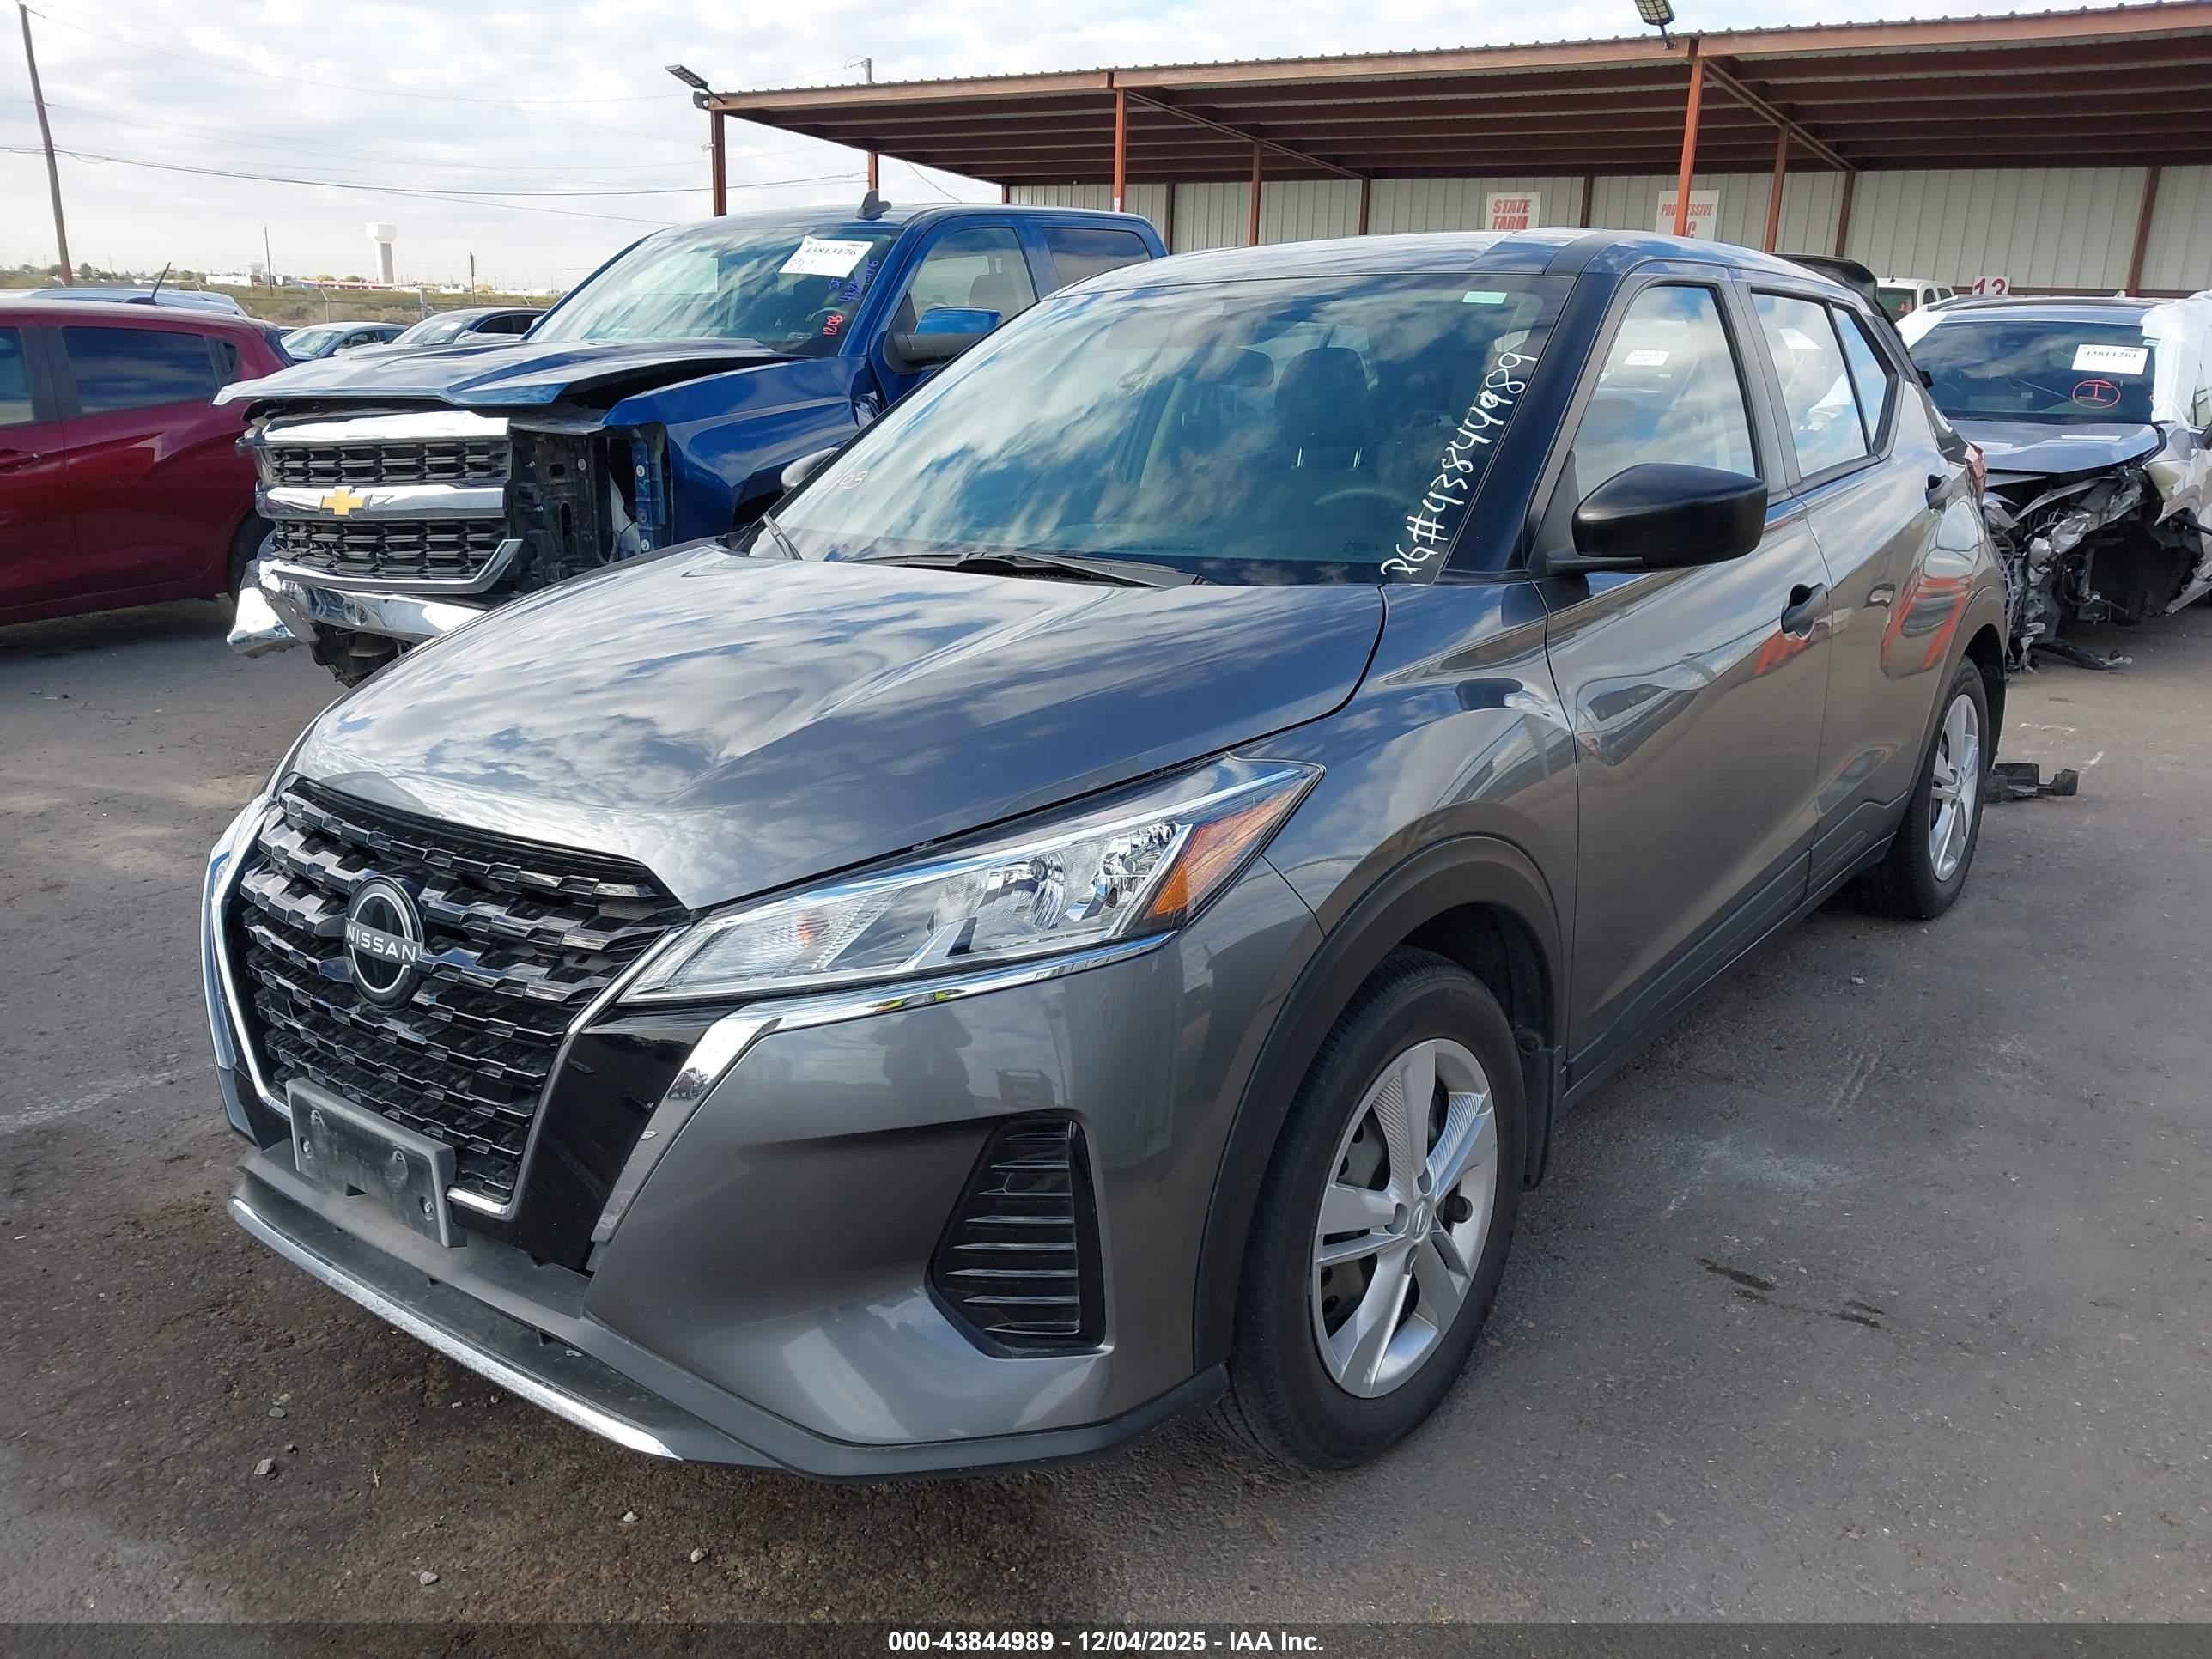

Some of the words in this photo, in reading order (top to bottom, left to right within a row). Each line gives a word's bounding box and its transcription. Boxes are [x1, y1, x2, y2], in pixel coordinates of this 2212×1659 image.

[1493, 198, 1532, 213] STATE
[1660, 203, 1713, 216] PROSSIVE
[1492, 215, 1529, 230] FARM
[2083, 350, 2137, 359] 43811201
[346, 923, 416, 963] NISSAN
